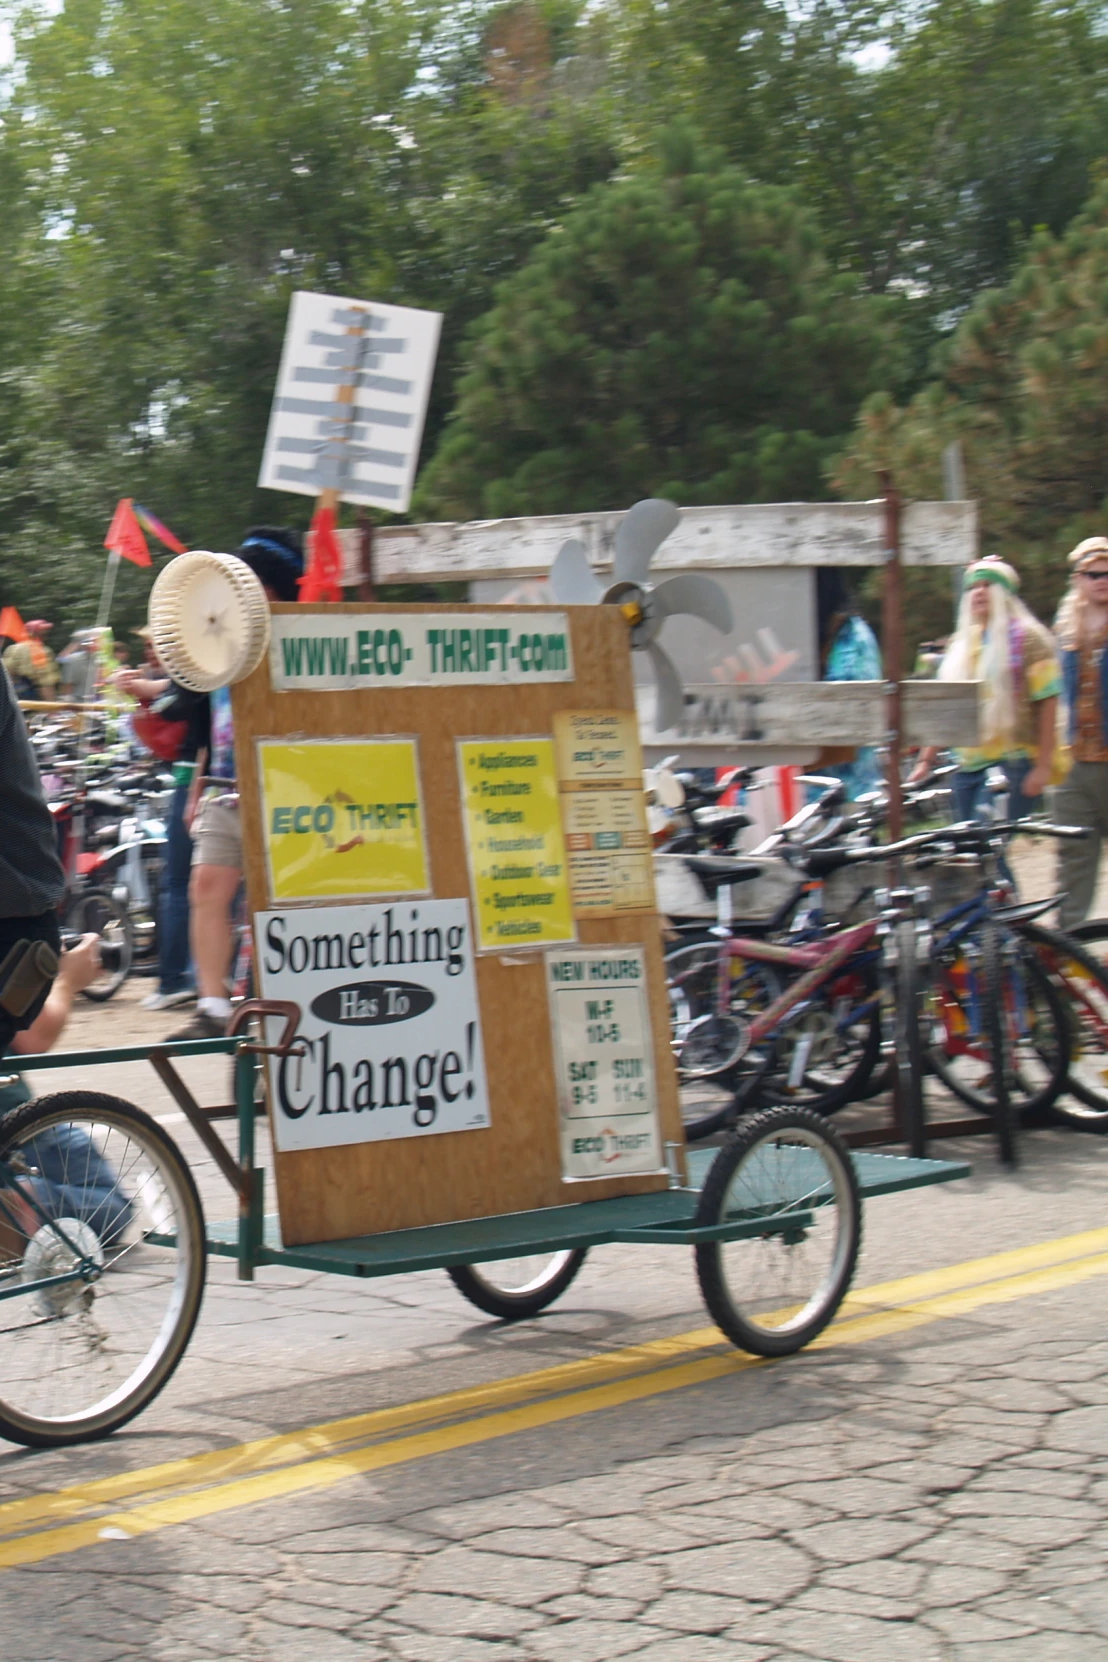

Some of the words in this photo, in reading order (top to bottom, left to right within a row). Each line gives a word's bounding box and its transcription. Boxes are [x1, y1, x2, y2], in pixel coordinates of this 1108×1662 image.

[478, 753, 537, 771] Appliances
[480, 780, 532, 796] Furniture
[271, 804, 336, 834] ECO
[345, 802, 420, 832] THRIFT
[484, 808, 524, 825] Garden
[488, 837, 544, 852] Household
[491, 864, 534, 880] Outdoor
[538, 861, 562, 877] Gear
[493, 892, 555, 911] Sportswear
[497, 920, 541, 936] Vehicles
[264, 908, 464, 976] Something
[551, 960, 586, 982] NEW
[588, 958, 642, 981] HOURS
[338, 990, 379, 1020] Has
[384, 986, 410, 1015] To
[587, 1022, 622, 1044] 10-5
[278, 1020, 476, 1127] Change!
[568, 1060, 598, 1082] SAT
[612, 1057, 644, 1080] SUN
[572, 1136, 605, 1155] ECO
[610, 1132, 652, 1151] THRIFT
